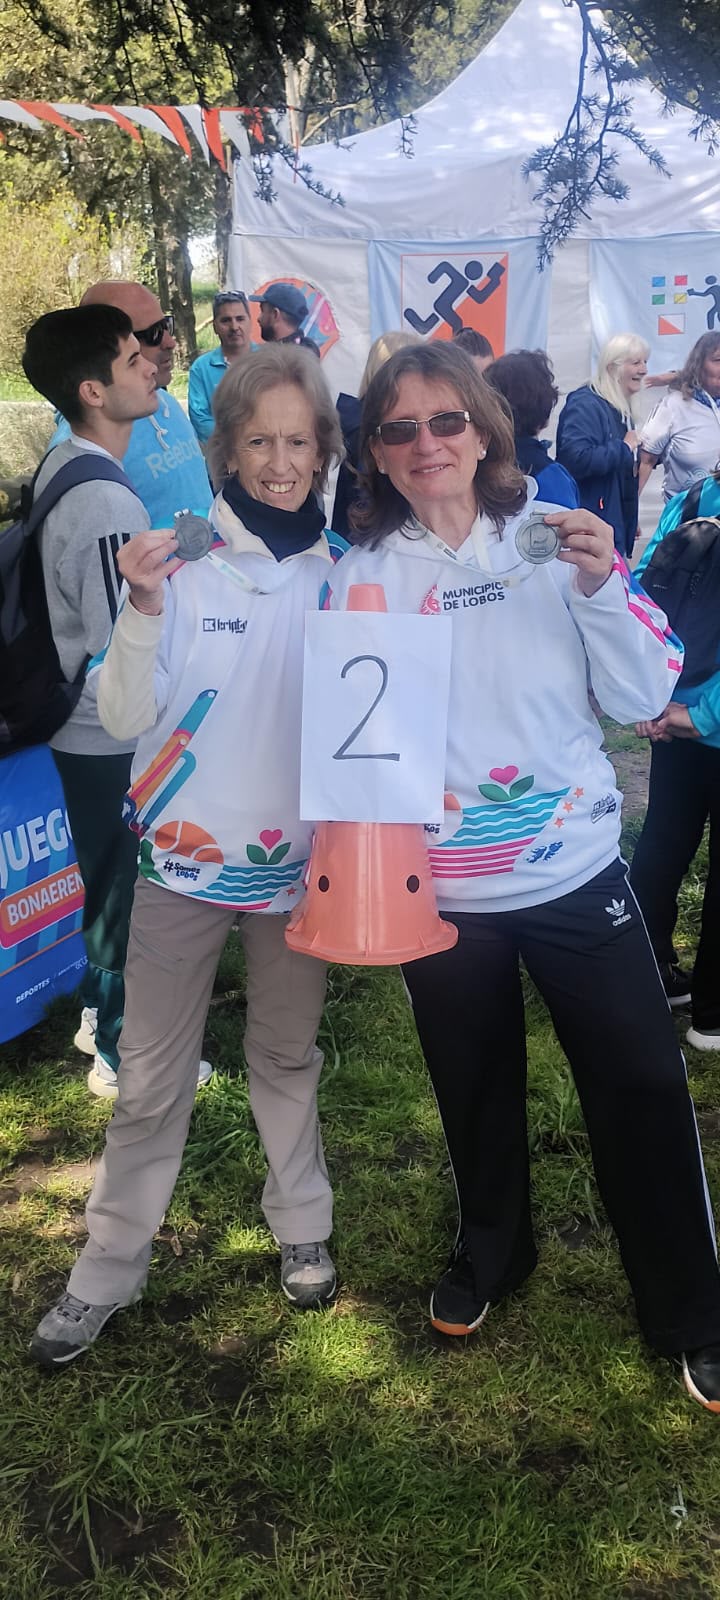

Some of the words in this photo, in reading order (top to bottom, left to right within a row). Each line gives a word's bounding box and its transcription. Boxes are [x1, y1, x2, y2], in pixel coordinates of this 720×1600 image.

[443, 600, 459, 611] DE
[463, 592, 505, 608] LOBOS
[333, 655, 400, 761] 2
[16, 977, 50, 1004] DEPORTES
